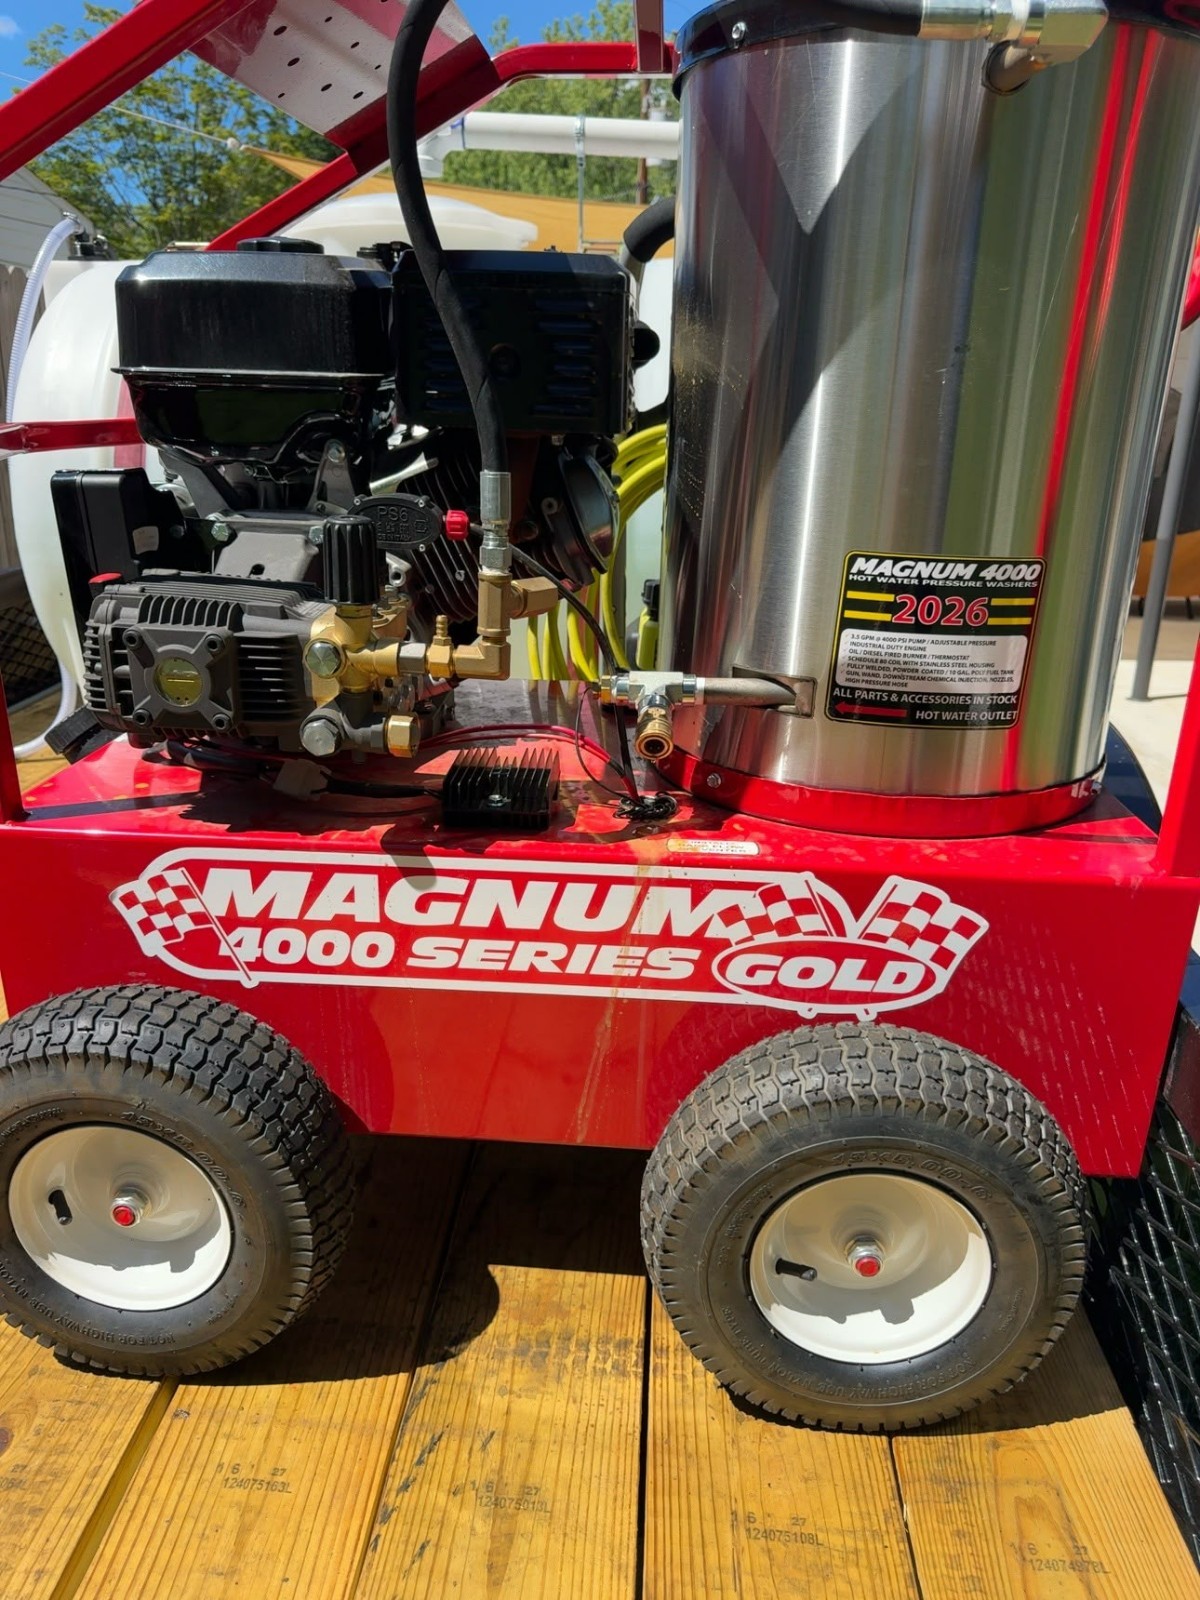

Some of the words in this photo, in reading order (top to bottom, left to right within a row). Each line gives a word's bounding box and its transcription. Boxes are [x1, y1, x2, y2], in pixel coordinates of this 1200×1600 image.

[378, 506, 408, 521] PS6
[850, 557, 978, 580] MAGNUM
[979, 564, 1041, 581] 4000
[849, 574, 874, 582] HOT
[876, 575, 919, 585] WATER
[923, 579, 983, 588] PRESSURE
[892, 594, 989, 627] 2026
[850, 641, 885, 650] INDUSTRIAL
[886, 643, 903, 651] DUTY
[863, 649, 883, 657] DIESEL
[884, 651, 902, 659] FIRED
[903, 652, 926, 660] BURNER
[848, 656, 878, 664] SCHEDULE
[919, 660, 950, 668] STAINLESS
[861, 679, 891, 687] PRESSURE
[882, 673, 926, 681] DOWNSTREAM
[833, 687, 852, 698] ALL
[854, 689, 888, 702] PARTS
[890, 693, 899, 702] &
[900, 693, 971, 705] ACCESSORIES
[973, 694, 984, 704] IN
[986, 695, 1018, 705] STOCK
[915, 710, 940, 720] HOT
[941, 711, 978, 721] WATER
[979, 710, 1018, 721] OUTLET
[198, 867, 757, 940] MAGNUM
[218, 926, 396, 968] 4000
[406, 936, 702, 980] SERIES
[725, 953, 926, 995] GOLD
[29, 1297, 54, 1320] USE
[56, 1312, 116, 1344] HIGHWAY
[271, 1467, 287, 1477] 27
[525, 1486, 540, 1496] 27
[791, 1516, 807, 1527] 27
